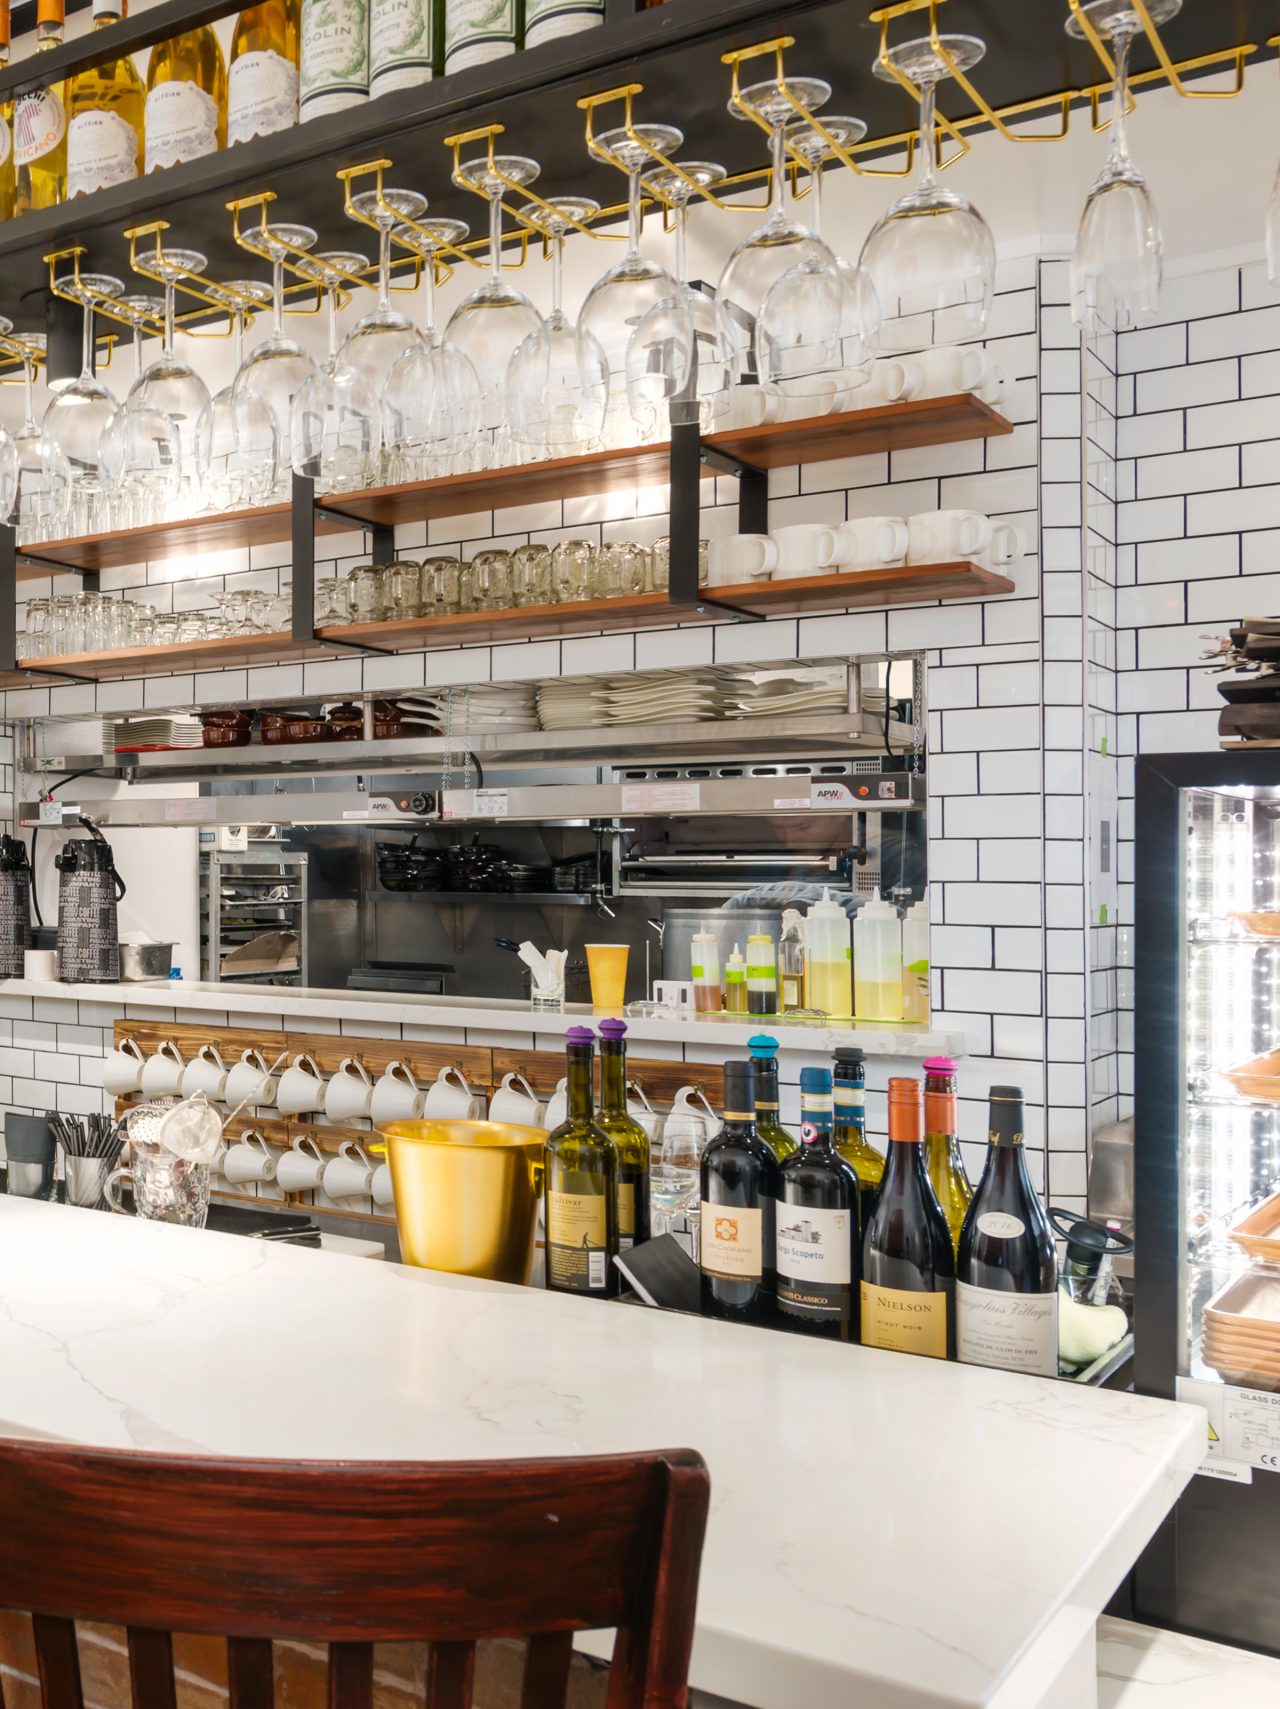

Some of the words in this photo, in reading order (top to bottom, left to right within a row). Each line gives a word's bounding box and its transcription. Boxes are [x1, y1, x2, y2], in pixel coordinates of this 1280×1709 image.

[305, 27, 351, 47] DOLIN
[79, 948, 99, 958] COFFEE
[791, 1247, 824, 1260] Scopeto
[794, 1293, 828, 1305] CLASSICO
[877, 1297, 932, 1313] NIELSON
[877, 1320, 898, 1328] PINOT
[1240, 1393, 1269, 1404] GLASS
